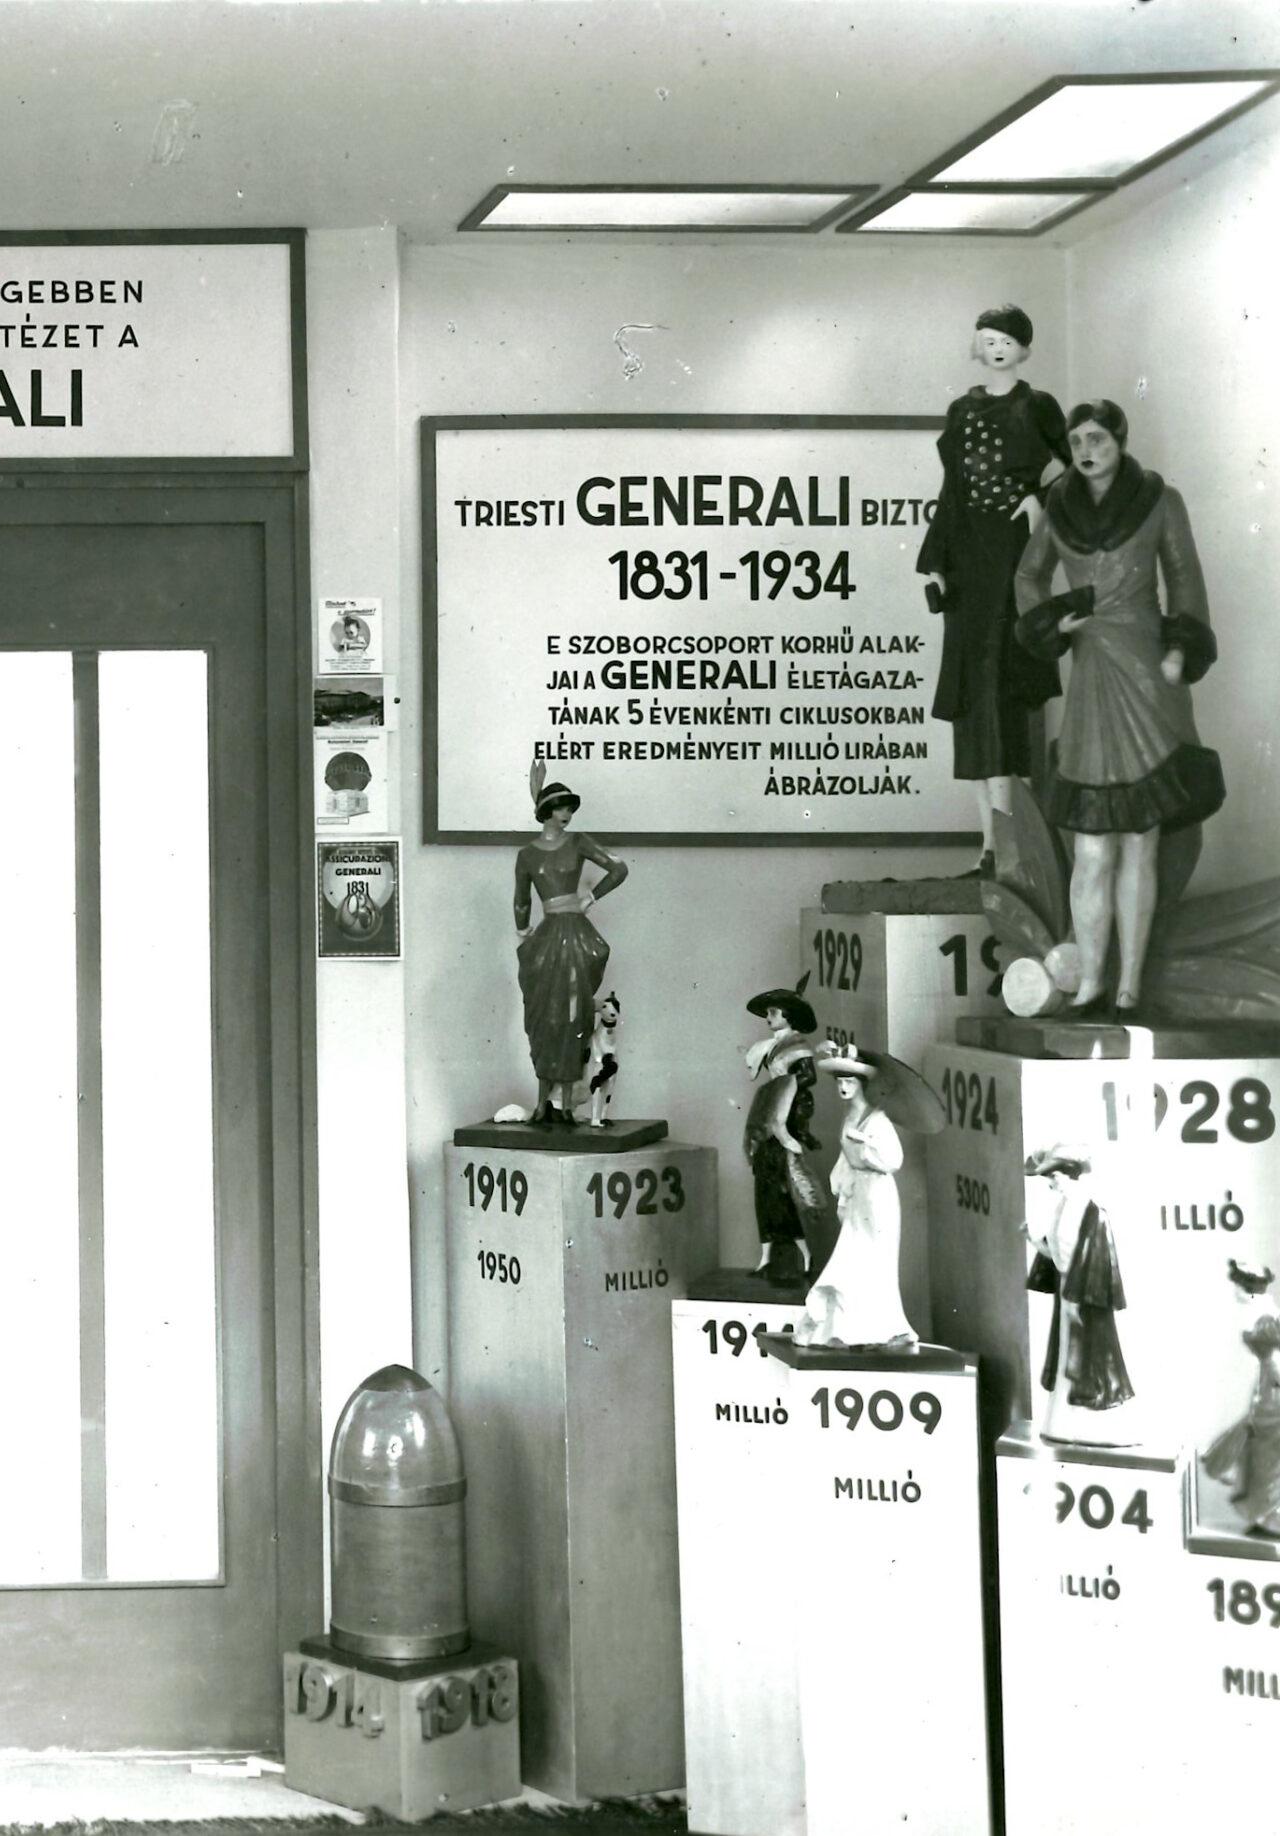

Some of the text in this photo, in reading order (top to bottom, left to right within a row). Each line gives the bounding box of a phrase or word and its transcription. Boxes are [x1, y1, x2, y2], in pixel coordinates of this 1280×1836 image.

[117, 324, 139, 348] A
[454, 499, 565, 527] TRIESTI
[576, 474, 850, 527] GENERALI
[547, 635, 561, 655] E
[568, 635, 775, 655] SZOBORCSOPORT
[858, 635, 926, 654] ALAK-
[546, 670, 579, 690] JAI
[583, 670, 596, 690] A
[600, 659, 777, 690] GENERALI
[547, 696, 925, 726] TÁNAK 5 ÉVENKÉNTI CIKLUSOKBAN
[533, 731, 928, 762] ELÉRT EREDMÉNYEIT MILLIÓ LIRÁBAN
[763, 764, 921, 796] ÁBRÁZOLJÁK.
[334, 867, 382, 877] GENERALI
[813, 928, 862, 992] 1929
[942, 1067, 1000, 1136] 1924
[1101, 1077, 1276, 1144] 128
[463, 1161, 529, 1218] 1919
[586, 1166, 686, 1220] 1923
[1160, 1190, 1245, 1232] ILLIÓ
[477, 1250, 521, 1285] 1950
[605, 1259, 669, 1292] MILLIÓ
[715, 1397, 789, 1425] MILLIÓ
[811, 1387, 942, 1435] 1909
[834, 1469, 922, 1503] MILLIÓ
[417, 1664, 517, 1742] 1918
